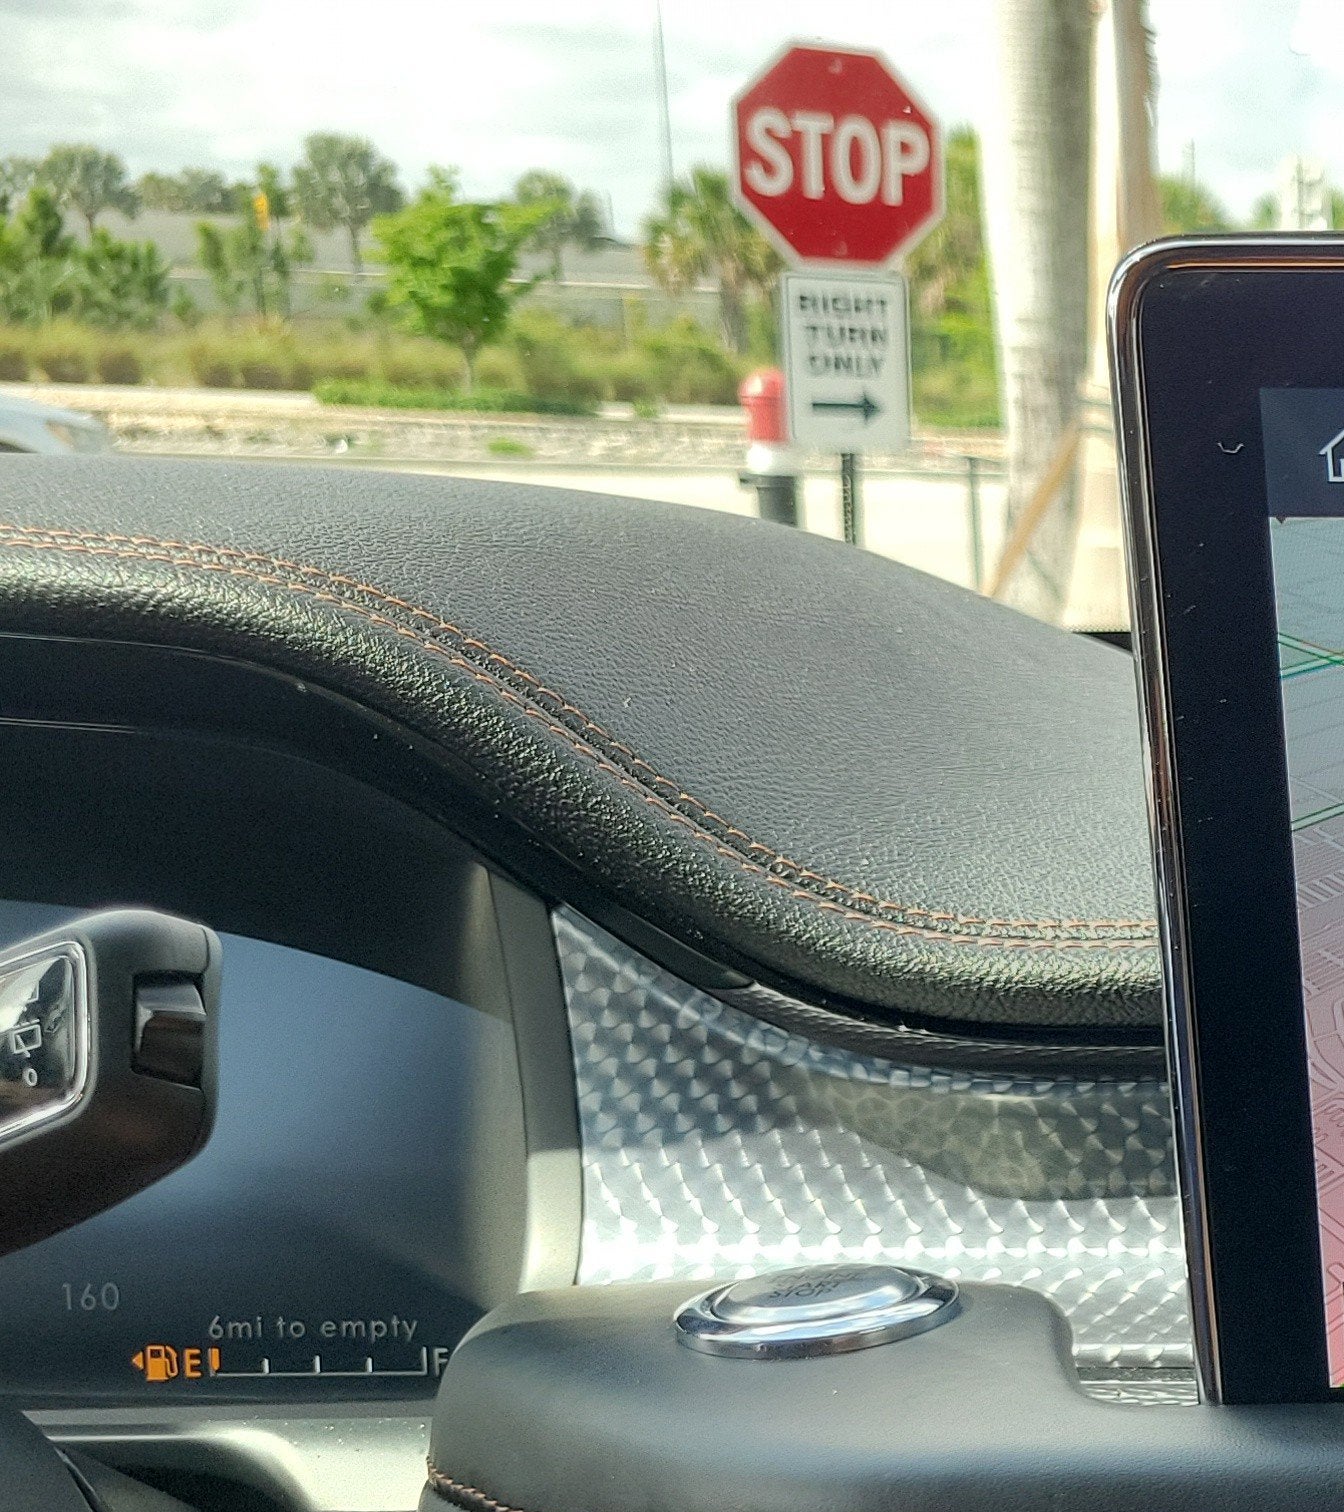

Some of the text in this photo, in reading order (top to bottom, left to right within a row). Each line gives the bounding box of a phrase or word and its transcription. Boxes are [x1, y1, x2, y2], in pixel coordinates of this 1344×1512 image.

[745, 108, 930, 206] STOP
[800, 294, 887, 315] RIGHT
[805, 325, 888, 346] TURN
[808, 355, 883, 376] ONLY
[62, 1283, 120, 1311] 160
[208, 1315, 418, 1341] 6mi to empty
[183, 1348, 202, 1379] E
